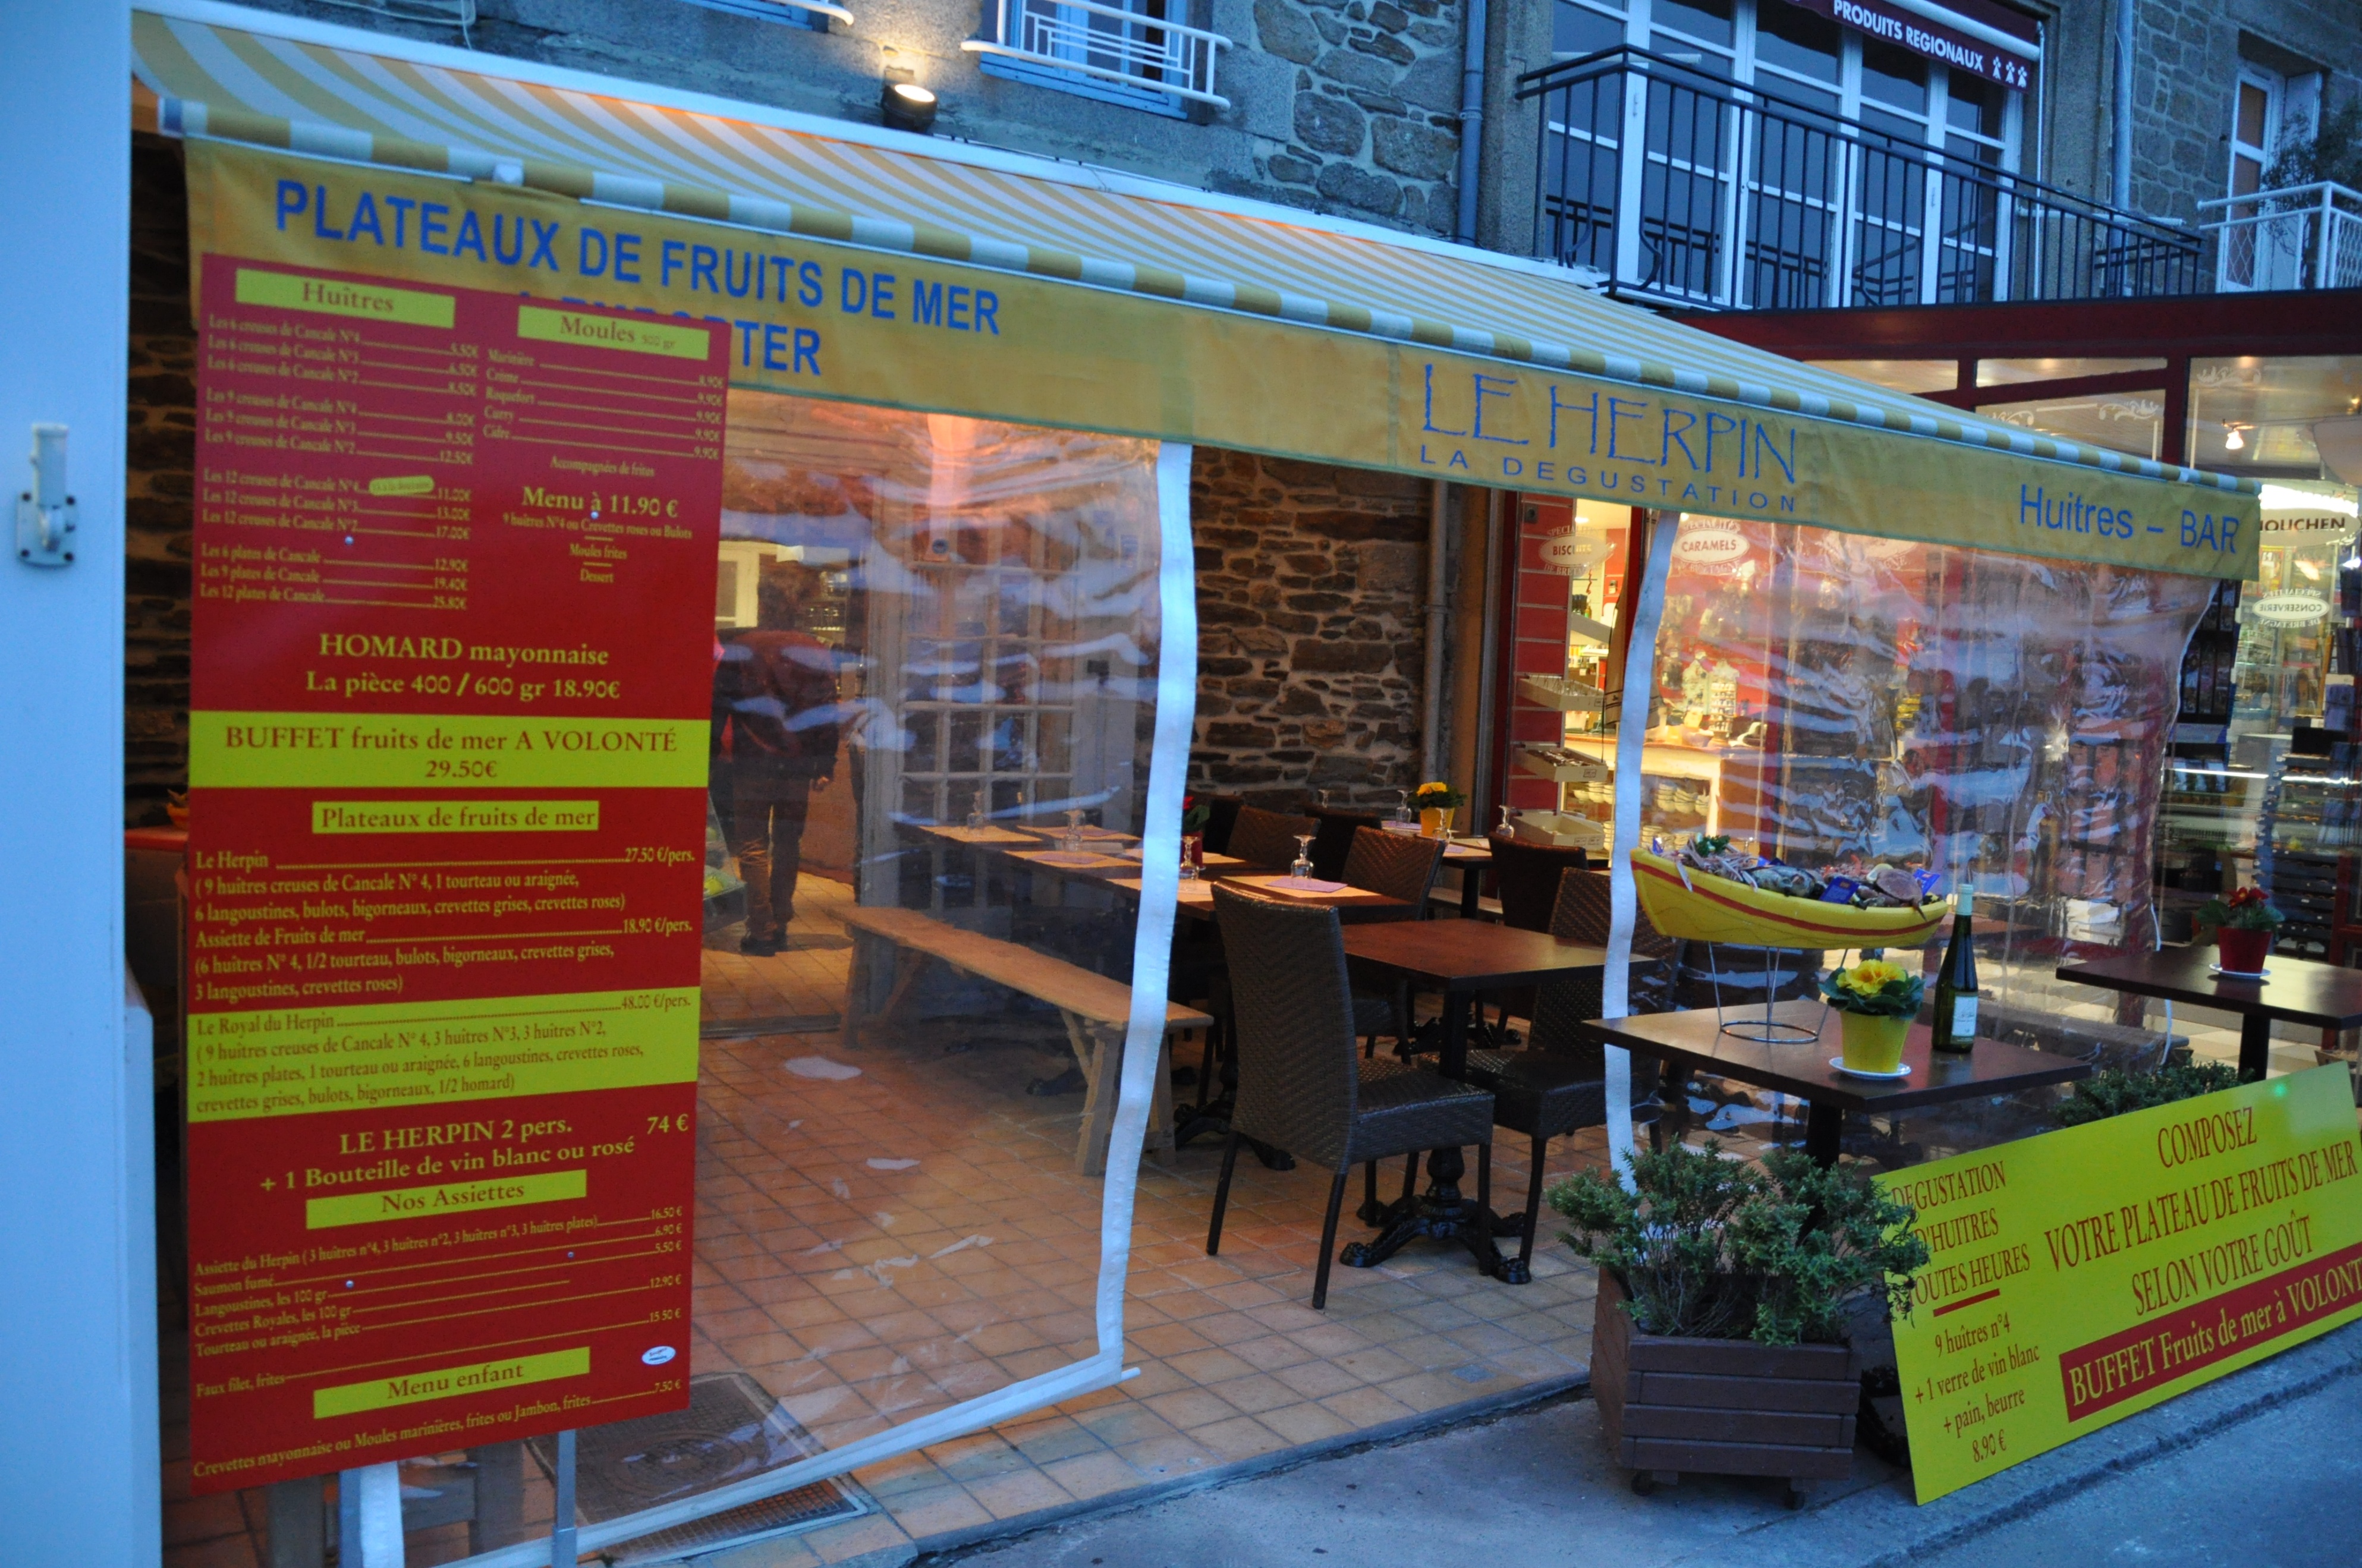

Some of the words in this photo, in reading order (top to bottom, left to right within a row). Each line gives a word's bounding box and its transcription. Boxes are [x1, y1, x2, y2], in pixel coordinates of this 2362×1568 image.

[1833, 0, 1902, 40] PRODUITS
[1906, 26, 1984, 73] REGIONAUX
[276, 179, 561, 271] PLATEAUX
[578, 234, 641, 282] DE
[662, 241, 822, 307] FRUITS
[840, 268, 896, 319] DE
[914, 279, 1000, 335] MER
[302, 281, 394, 312] Huîtres
[560, 316, 635, 342] Moules
[1423, 364, 1529, 445] LE
[1549, 385, 1795, 484] HERPIN
[1420, 445, 1468, 468] LA
[1504, 456, 1795, 513] DEGUSTATION
[522, 486, 584, 510] Menu
[592, 492, 602, 511] à
[611, 495, 661, 517] 11.90
[666, 500, 678, 518] €
[2021, 484, 2133, 539] Huitres
[2181, 511, 2240, 553] BAR
[2260, 517, 2345, 531] OUCHEN
[1681, 539, 1737, 552] CARAMELS
[319, 633, 463, 660] HOMARD
[470, 644, 609, 667] mayonnaise
[306, 670, 337, 691] La
[345, 673, 405, 698] pièce
[411, 674, 452, 694] 400
[475, 677, 512, 696] 600
[520, 681, 545, 702] gr
[553, 680, 620, 699] 18.90€
[225, 726, 344, 750] BUFFET
[351, 727, 417, 750] fruits
[427, 730, 453, 750] de
[461, 733, 507, 750] mer
[514, 731, 533, 751] A
[544, 727, 677, 752] VOLONTÉ
[424, 759, 497, 779] 29.50€
[322, 807, 419, 830] Plateaux
[428, 807, 453, 827] de
[460, 807, 517, 827] fruits
[526, 807, 549, 826] de
[554, 811, 595, 826] mer
[196, 851, 213, 869] Le
[218, 851, 269, 873] Herpin
[625, 848, 654, 862] 27.50
[271, 878, 319, 892] creuses
[323, 874, 338, 891] de
[341, 872, 395, 890] Cancale
[446, 874, 501, 889] tourteau
[505, 875, 521, 887] ou
[524, 870, 579, 890] araignée,
[195, 907, 203, 921] 6
[207, 901, 300, 925] langoustines,
[303, 899, 349, 918] bulots,
[353, 899, 432, 921] bigorneaux,
[435, 898, 490, 914] crevettes
[493, 895, 532, 917] grises,
[535, 897, 589, 911] crevettes
[592, 893, 626, 911] roses)
[196, 930, 251, 948] Assiette
[254, 928, 271, 945] de
[275, 927, 316, 944] Fruits
[320, 925, 335, 943] de
[339, 929, 364, 942] mer
[623, 918, 652, 934] 18.90
[197, 1019, 213, 1035] Le
[219, 1017, 260, 1037] Royal
[264, 1016, 281, 1031] du
[285, 1012, 334, 1034] Herpin
[339, 1132, 375, 1154] LE
[383, 1120, 494, 1150] HERPIN
[501, 1120, 514, 1139] 2
[520, 1119, 573, 1143] pers.
[647, 1116, 669, 1135] 74
[676, 1114, 688, 1131] €
[2158, 1107, 2257, 1168] COMPOSEZ
[285, 1172, 295, 1189] 1
[306, 1159, 410, 1187] Bouteille
[417, 1155, 443, 1175] de
[449, 1153, 485, 1172] vin
[493, 1147, 551, 1166] blanc
[557, 1146, 584, 1160] ou
[591, 1136, 636, 1157] rosé
[382, 1193, 425, 1213] Nos
[433, 1184, 524, 1206] Assiettes
[1891, 1160, 2006, 1210] DEGUSTATION
[2044, 1214, 2121, 1271] VOTRE
[2122, 1185, 2209, 1249] PLATEAU
[2210, 1180, 2237, 1221] DE
[2238, 1157, 2299, 1210] FRUITS
[2298, 1152, 2323, 1191] DE
[2322, 1141, 2358, 1183] MER
[1972, 1243, 2031, 1288] HEURES
[2132, 1256, 2198, 1315] SELON
[2199, 1234, 2263, 1290] VOTRE
[2263, 1210, 2314, 1266] GOÛT
[1935, 1334, 1942, 1357] 9
[1946, 1324, 1988, 1354] huîtres
[2069, 1337, 2154, 1406] BUFFET
[2159, 1321, 2215, 1369] Fruits
[2218, 1308, 2237, 1346] de
[2241, 1305, 2273, 1338] mer
[2274, 1290, 2286, 1323] à
[2286, 1257, 2362, 1317] VOLONT
[387, 1376, 450, 1399] Menu
[457, 1365, 524, 1387] enfant
[1927, 1378, 1933, 1401] 1
[1937, 1372, 1969, 1395] verre
[1972, 1359, 1986, 1384] de
[1988, 1351, 2008, 1375] vin
[2009, 1343, 2040, 1370] blanc
[1955, 1401, 1985, 1438] pain,
[1986, 1389, 2026, 1418] beurre
[193, 1456, 255, 1478] Crevettes
[258, 1441, 332, 1465] mayonnaise
[335, 1438, 351, 1450] ou
[355, 1430, 397, 1448] Moules
[466, 1412, 495, 1428] frites
[497, 1410, 512, 1422] ou
[514, 1402, 561, 1423] Jambon,
[563, 1395, 591, 1410] frites
[1972, 1432, 1997, 1463] 8.90
[1999, 1429, 2008, 1451] €
